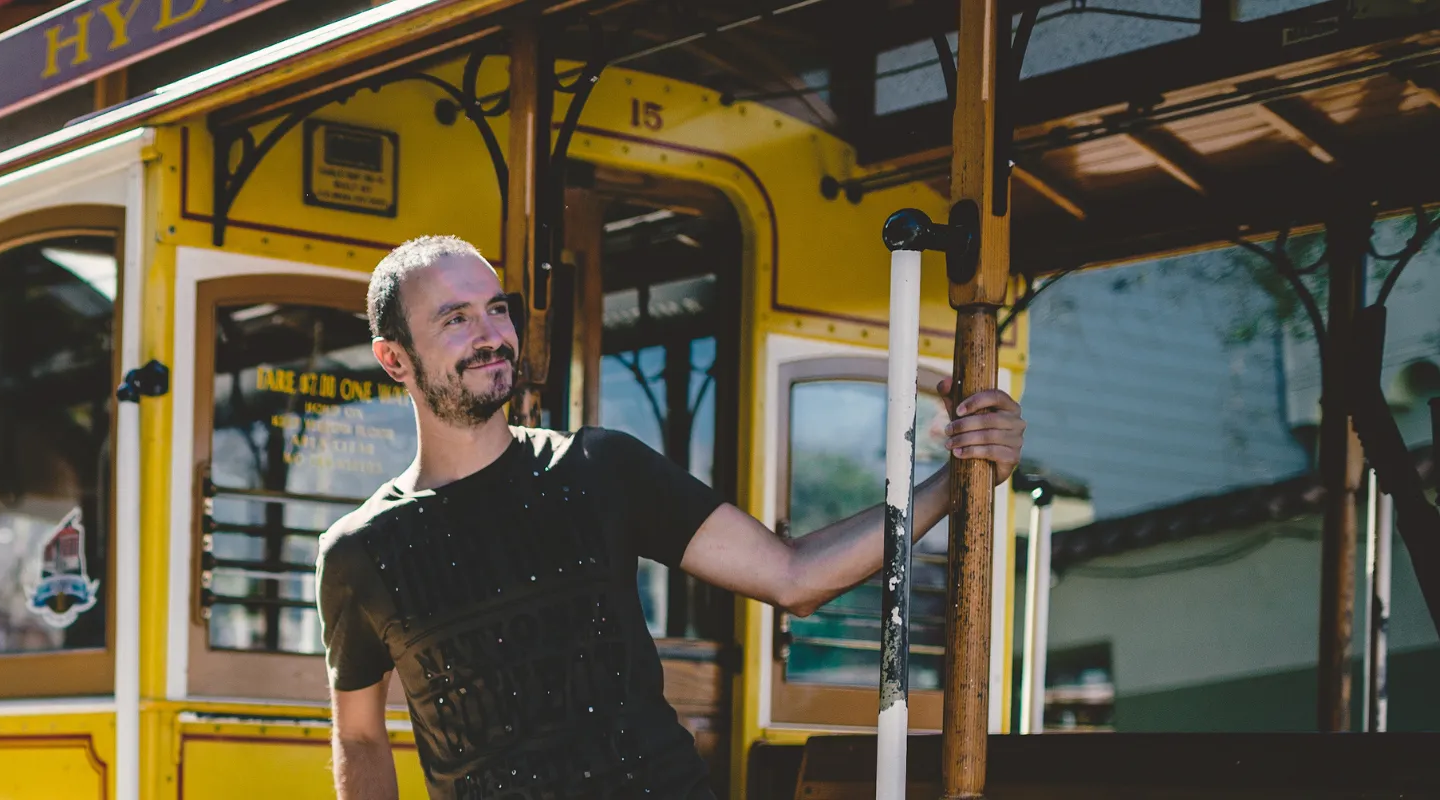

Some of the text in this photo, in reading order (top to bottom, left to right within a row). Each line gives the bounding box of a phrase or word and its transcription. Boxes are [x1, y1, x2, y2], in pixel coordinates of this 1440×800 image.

[40, 0, 234, 79] HYD
[631, 97, 663, 131] 15
[257, 367, 295, 394] FARE
[340, 378, 372, 403] ONE
